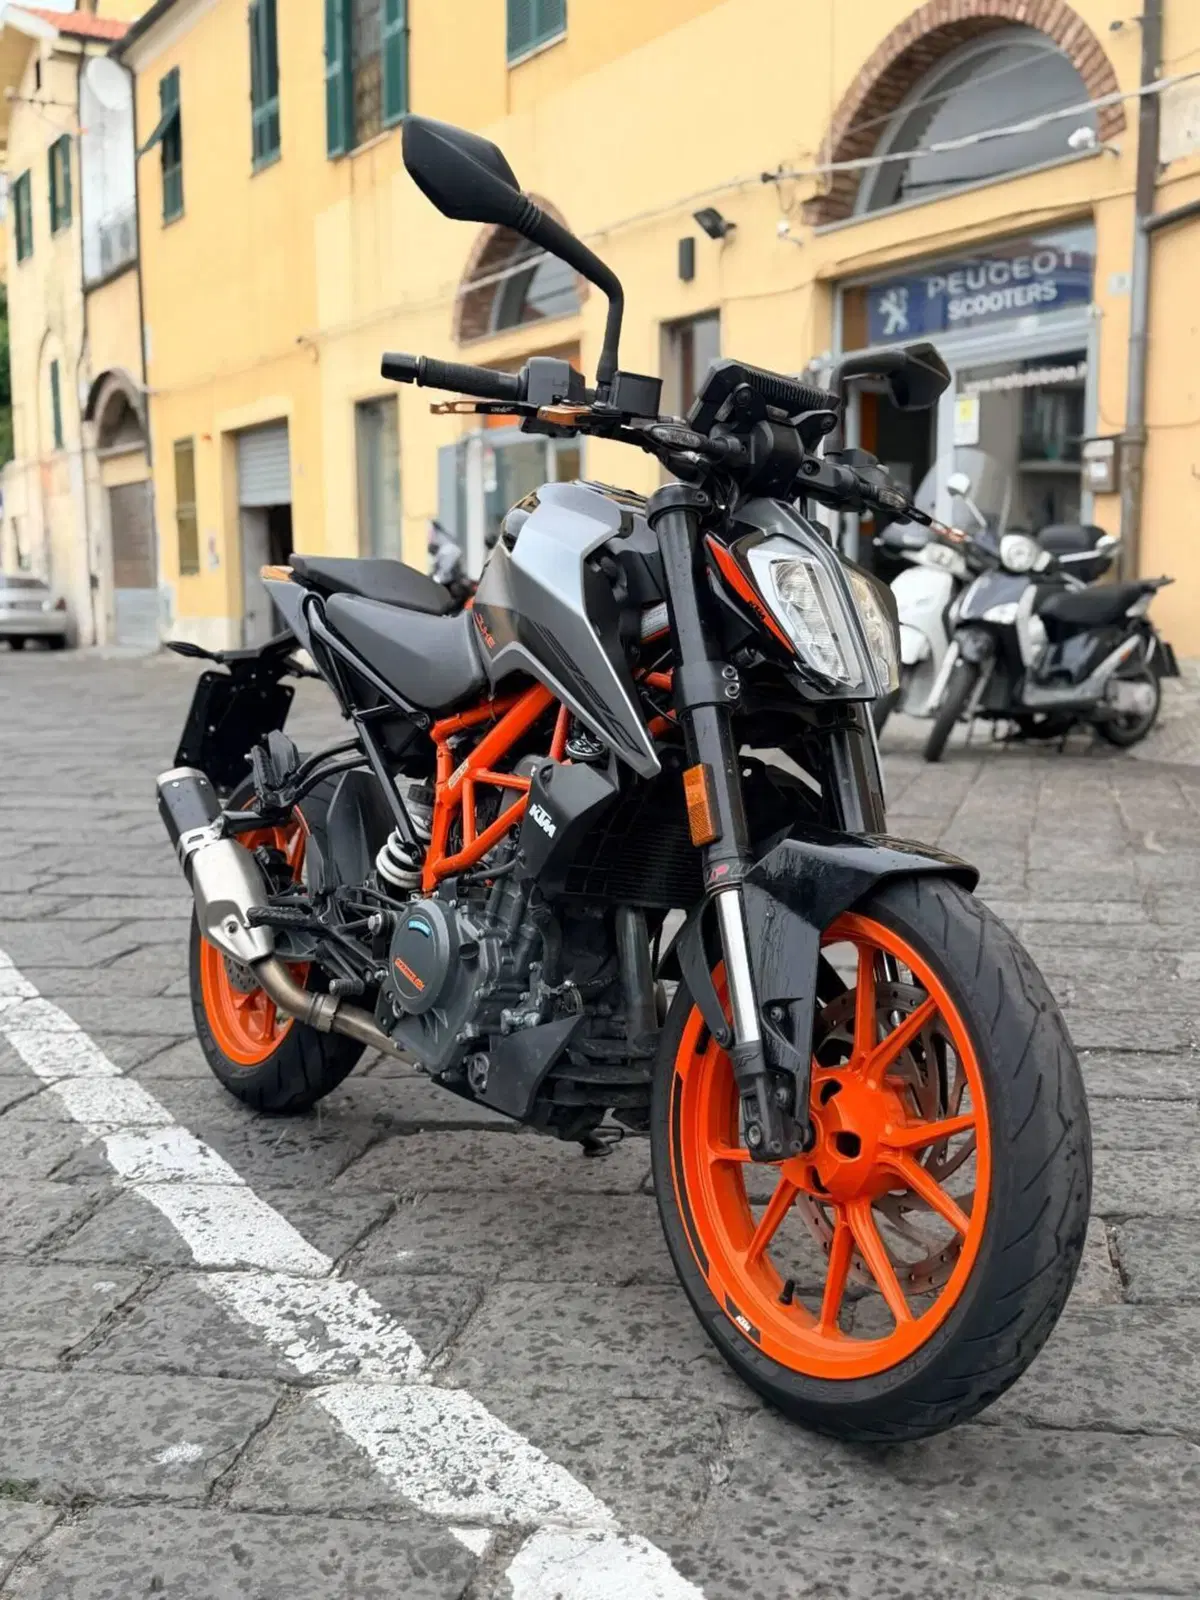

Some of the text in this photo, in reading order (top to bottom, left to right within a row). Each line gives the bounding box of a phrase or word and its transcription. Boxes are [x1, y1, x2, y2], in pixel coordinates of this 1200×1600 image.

[927, 249, 1074, 298] PEUGEOT
[946, 279, 1058, 321] SCOOTERS
[528, 803, 557, 839] KTM
[735, 1315, 752, 1332] KTM
